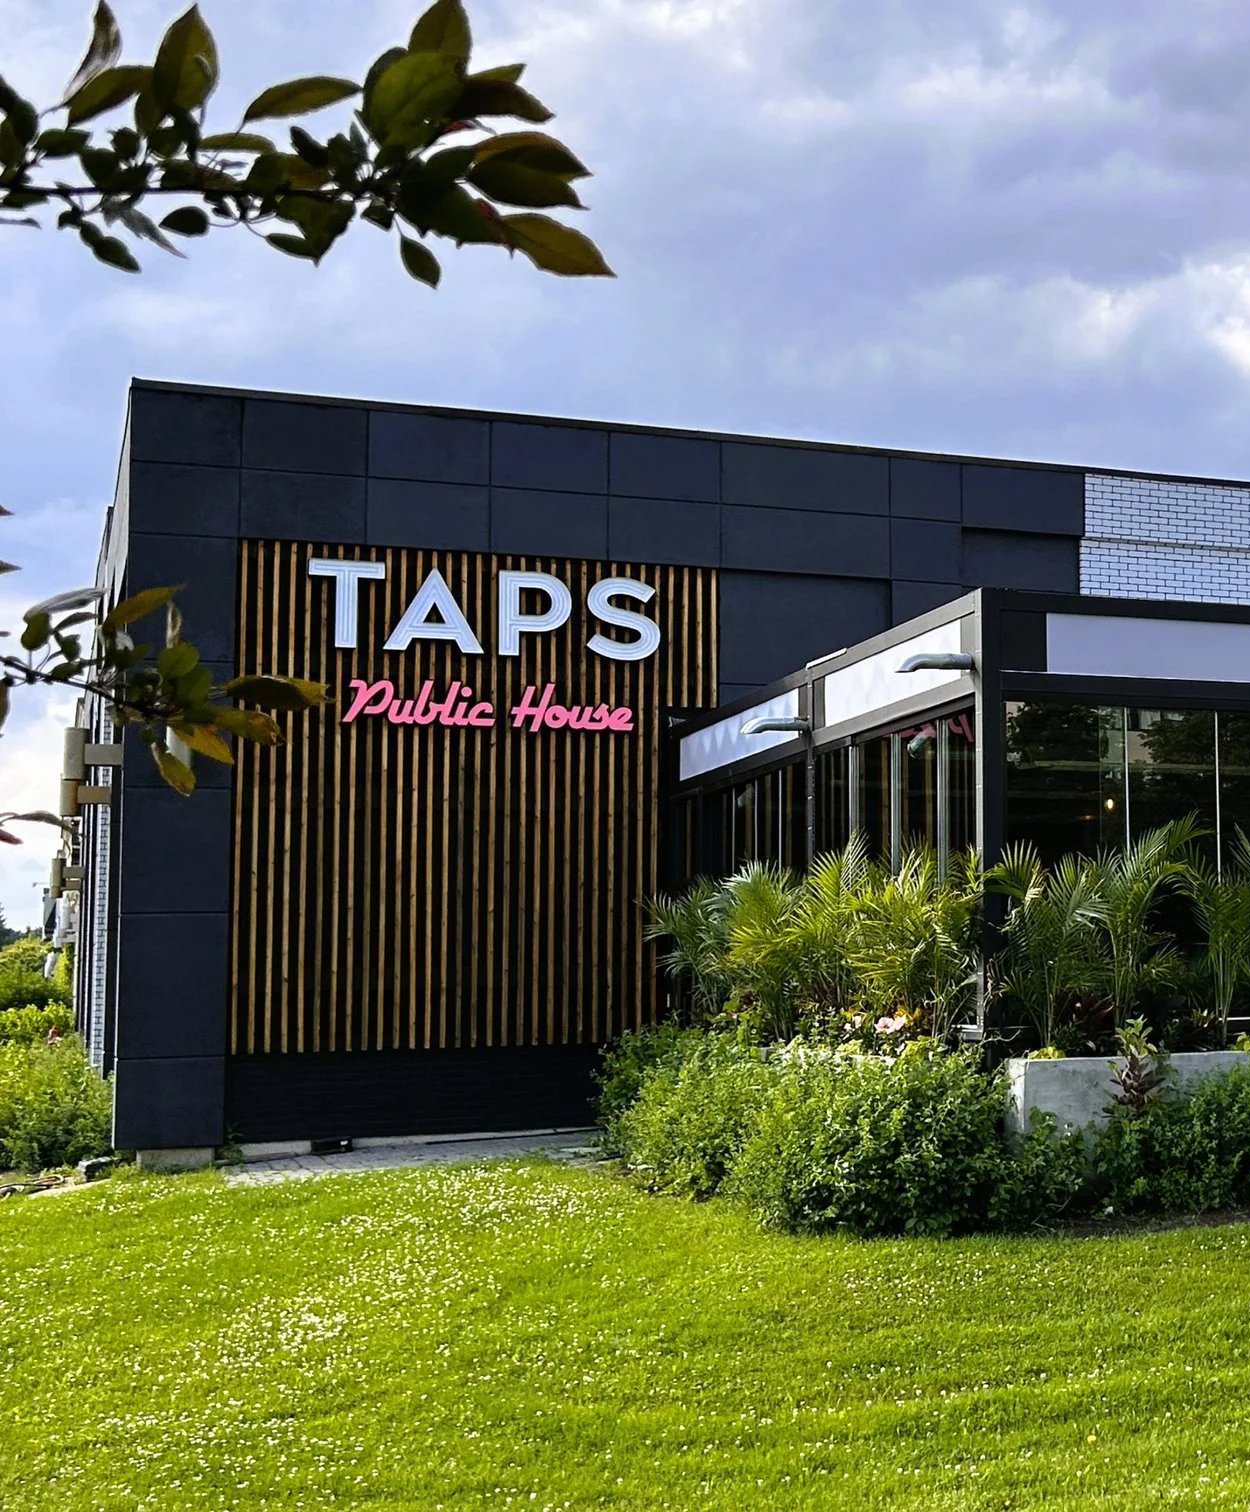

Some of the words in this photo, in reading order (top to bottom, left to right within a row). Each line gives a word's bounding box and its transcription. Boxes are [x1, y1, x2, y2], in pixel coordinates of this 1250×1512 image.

[307, 557, 661, 662] TAPS
[341, 678, 497, 728] Public
[511, 682, 634, 733] House
